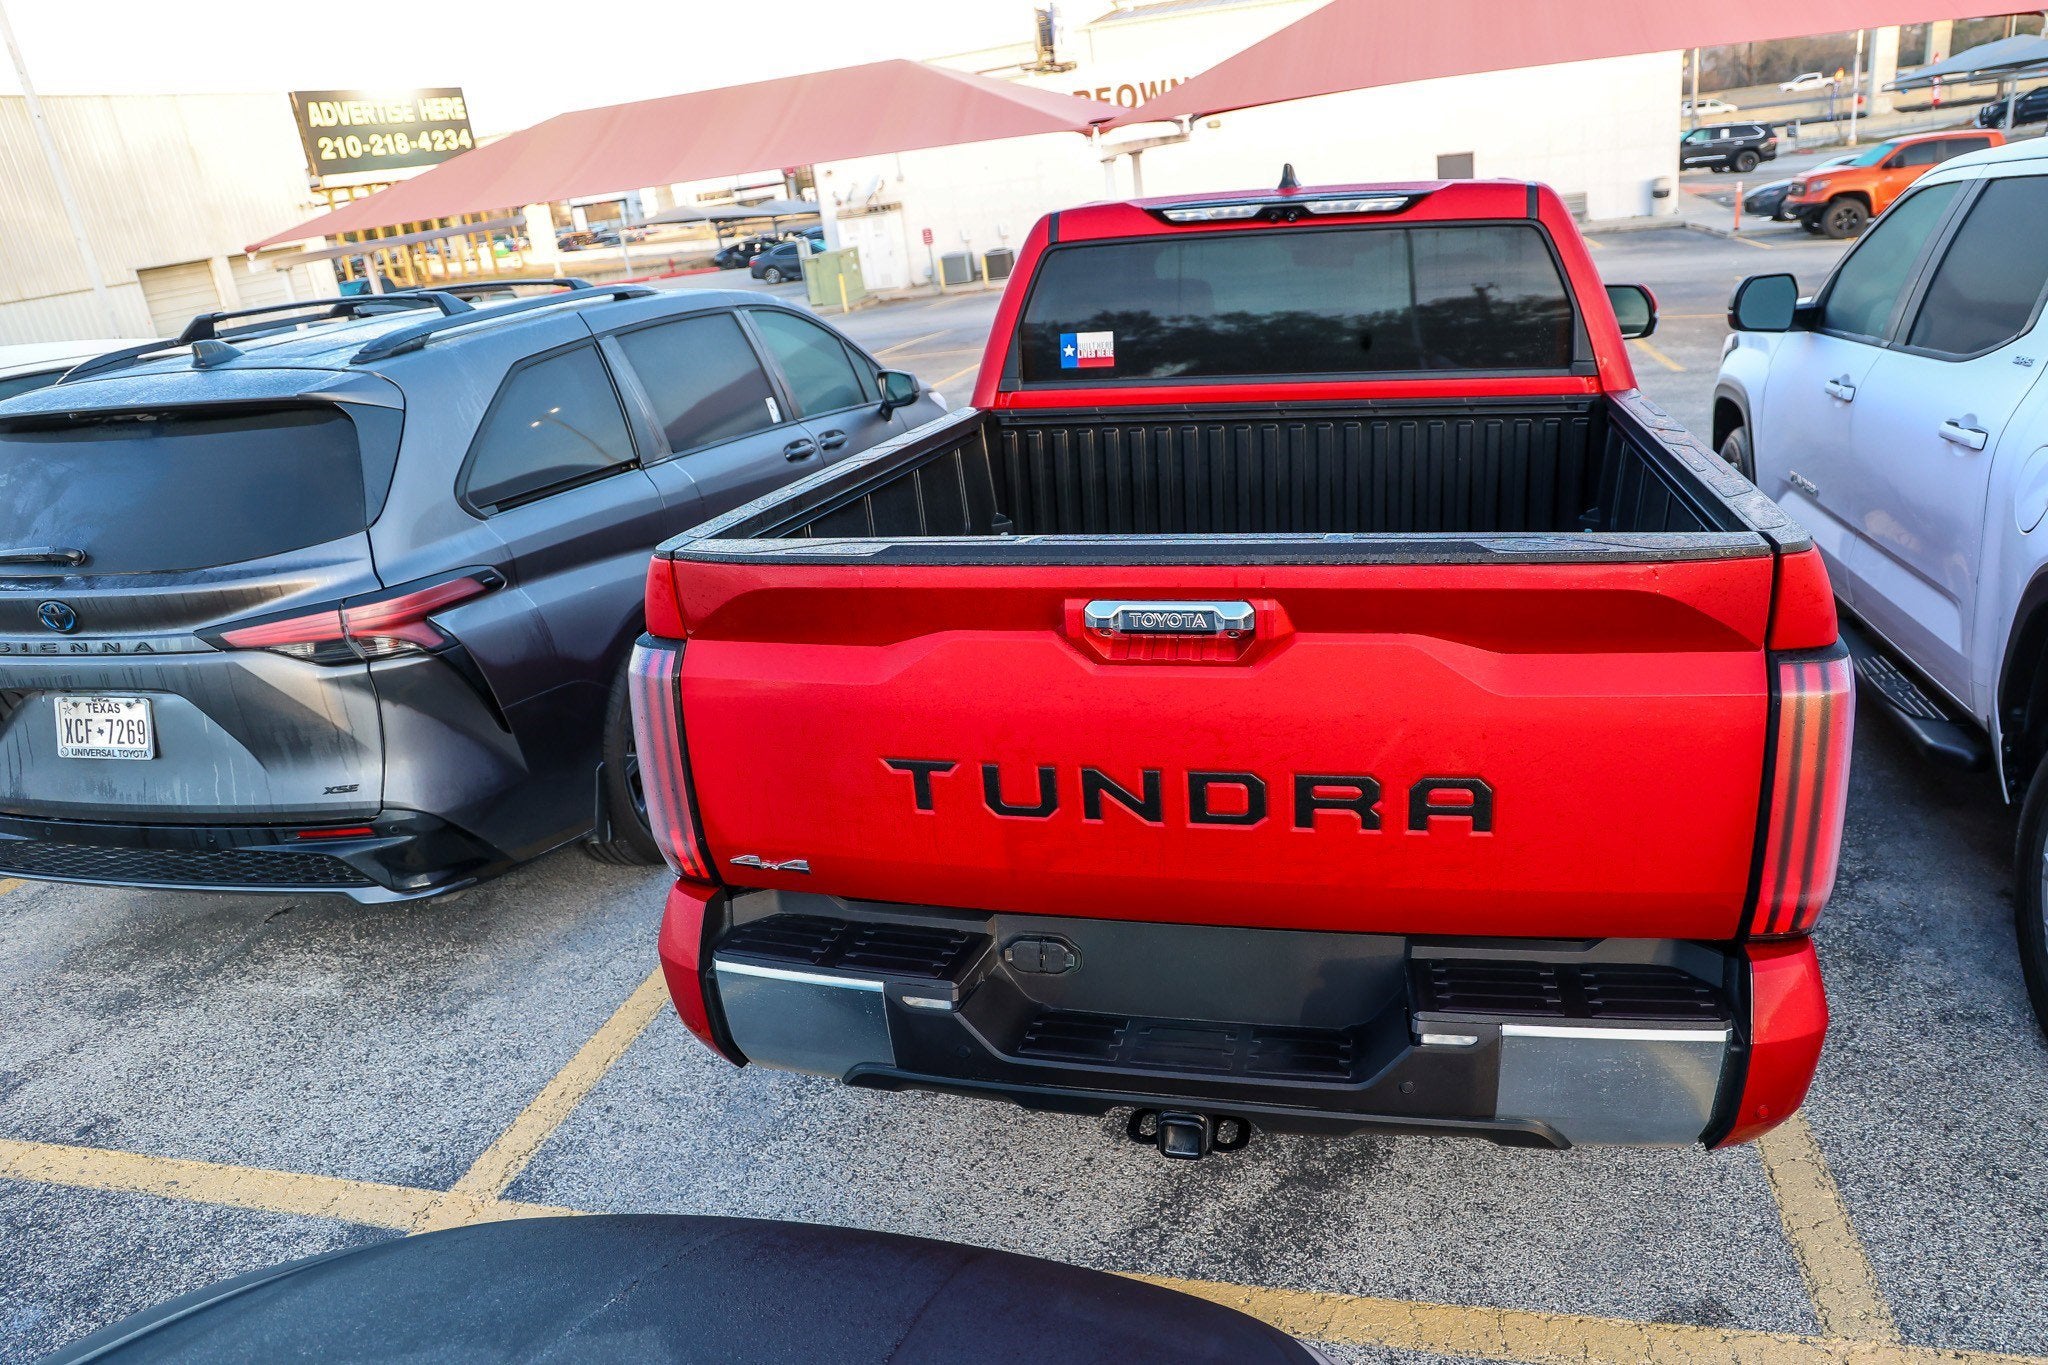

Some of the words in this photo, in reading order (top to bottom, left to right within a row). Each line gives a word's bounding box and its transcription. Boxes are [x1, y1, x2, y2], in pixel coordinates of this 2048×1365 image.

[307, 100, 416, 128] ADVERTISE
[417, 96, 467, 122] HERE
[317, 128, 473, 161] 210-218-4234
[1129, 612, 1207, 628] TOYOTA
[0, 641, 155, 653] SIENNA
[85, 702, 121, 714] TEXAS
[65, 718, 93, 744] XCF
[105, 719, 146, 745] 7269
[71, 747, 117, 758] UNIVERSAL
[118, 749, 149, 759] TOYOTA
[322, 783, 360, 796] XSE
[879, 758, 1495, 837] TUNDRA
